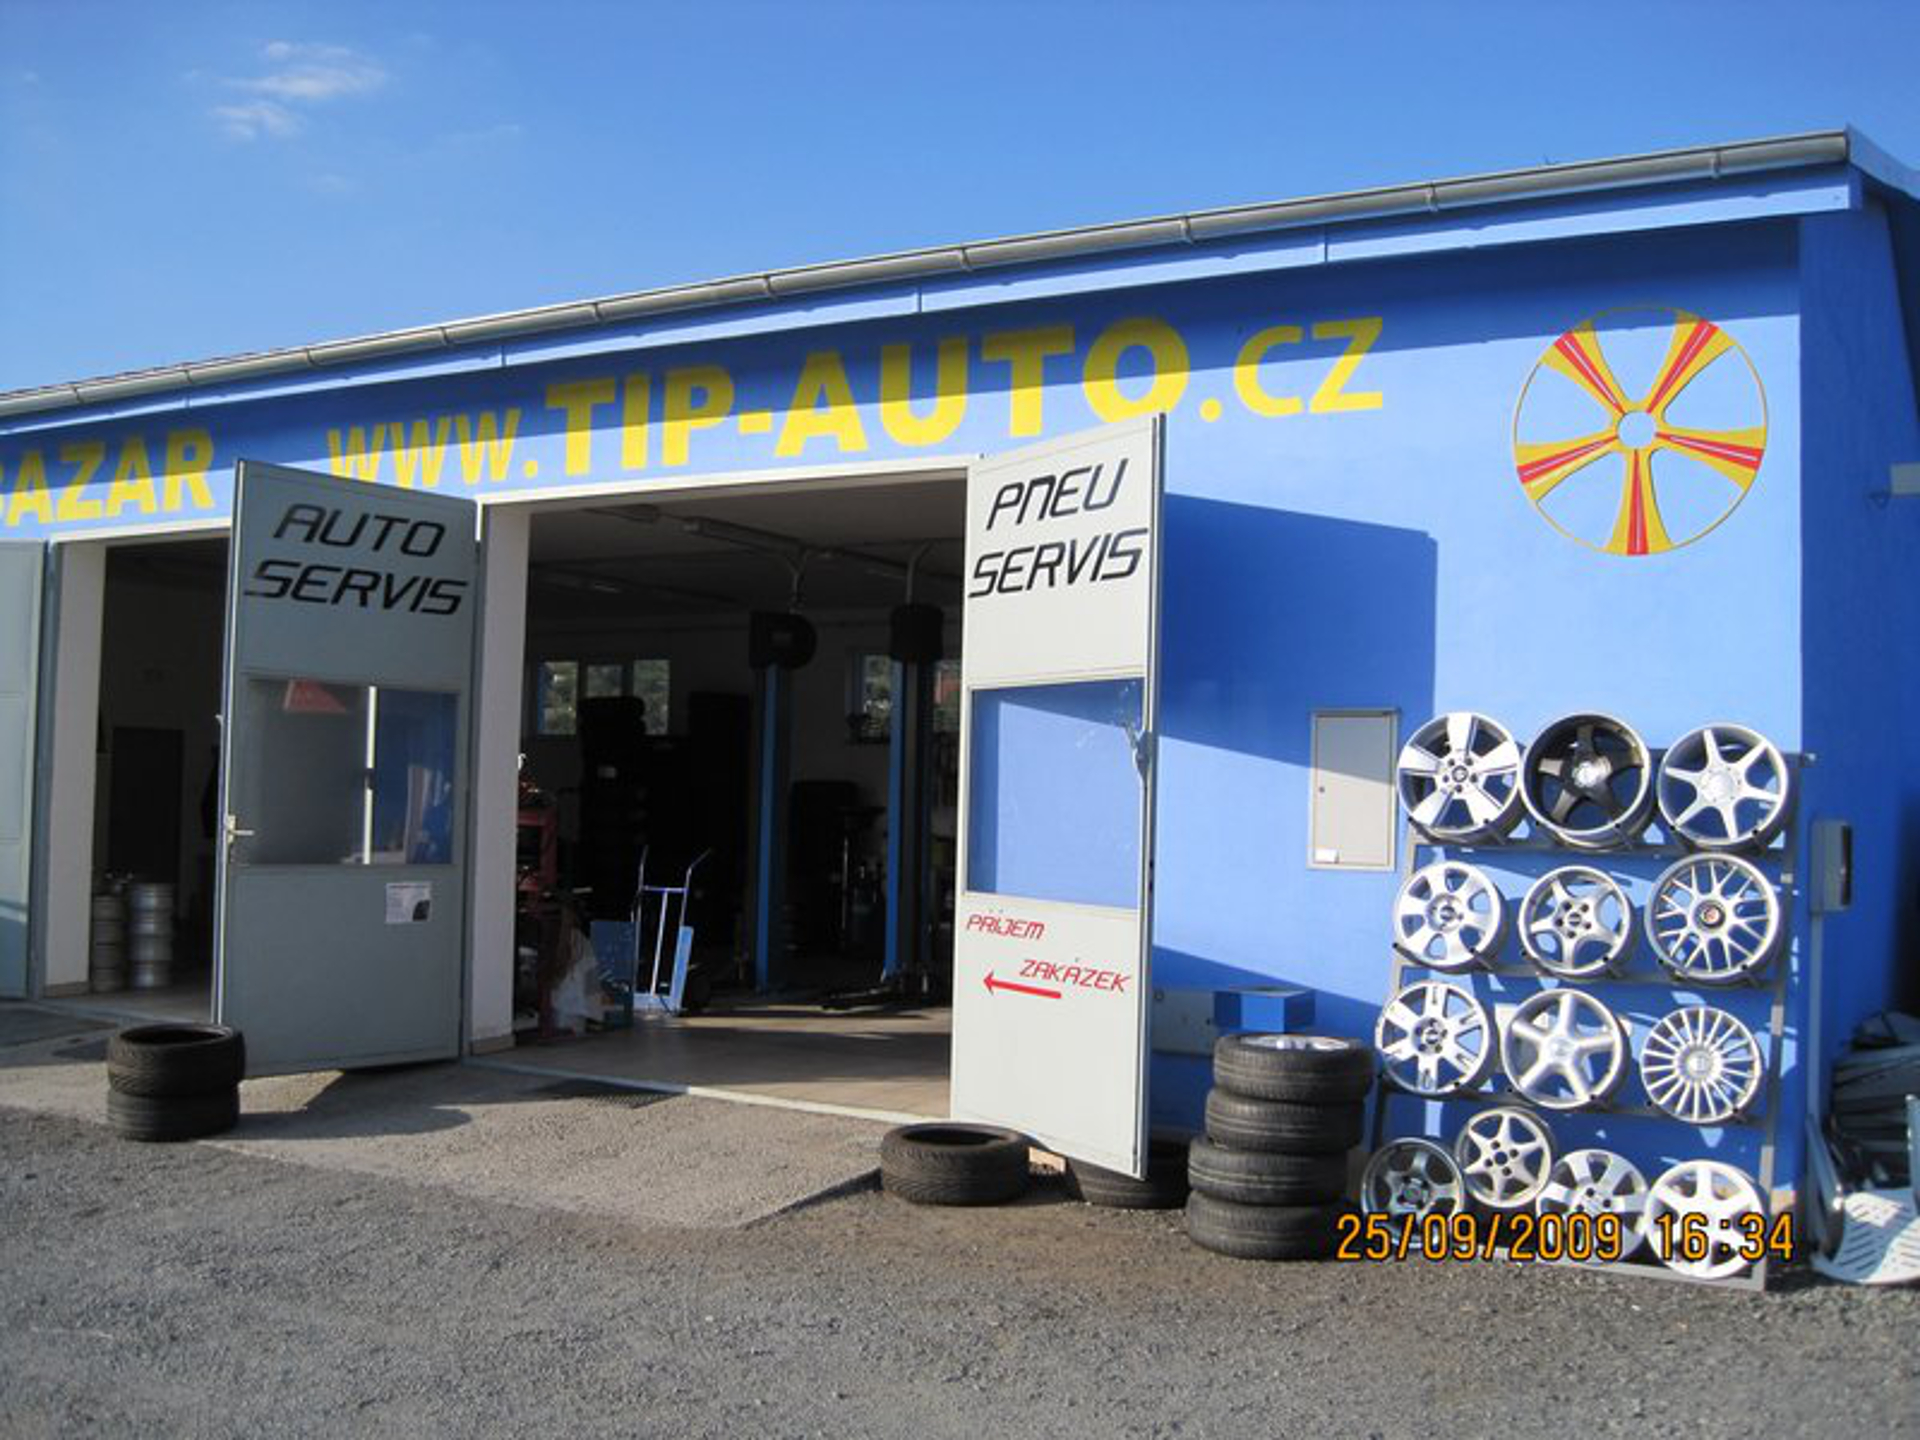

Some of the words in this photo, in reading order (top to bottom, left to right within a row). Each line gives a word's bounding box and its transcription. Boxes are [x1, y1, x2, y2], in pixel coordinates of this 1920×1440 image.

[0, 429, 214, 526] AZAR
[987, 458, 1128, 530] PNEU
[273, 503, 445, 558] AUTO
[244, 559, 468, 616] SERVIS
[968, 528, 1148, 598] SERVIS
[1020, 956, 1131, 992] ZAKÁZEK
